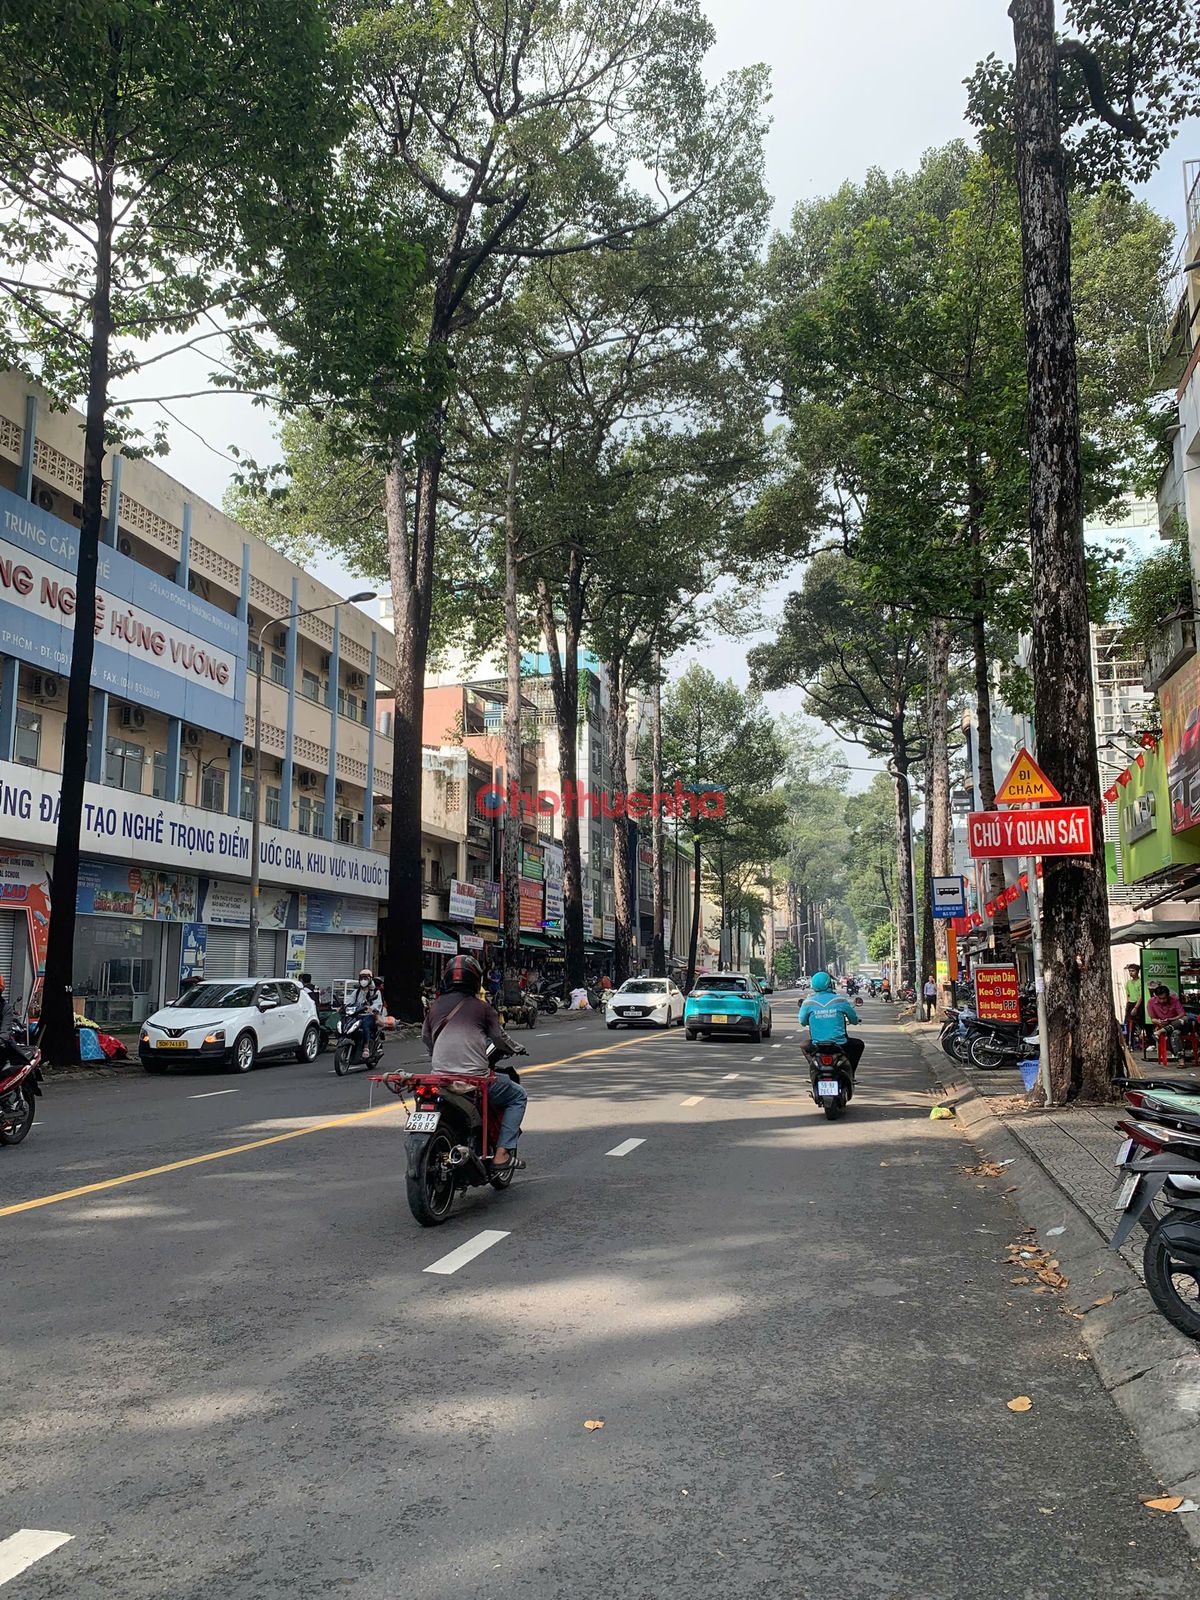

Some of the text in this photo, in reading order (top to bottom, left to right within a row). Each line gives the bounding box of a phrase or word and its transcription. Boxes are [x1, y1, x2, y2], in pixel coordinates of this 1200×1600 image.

[4, 511, 47, 546] TRUNG
[40, 576, 105, 635] NGỆ
[110, 609, 165, 657] HÙNG
[169, 637, 230, 686] VƯƠNG
[1018, 770, 1031, 781] ĐI
[1008, 782, 1044, 797] CHẬM
[973, 812, 1085, 847] CHÚ Ý QUAN SÁT
[84, 803, 116, 838] TẠO
[122, 810, 164, 844] NGHỀ
[169, 821, 214, 856] TRỌNG
[218, 826, 249, 860] ĐIỂM
[260, 837, 282, 866] UỐC
[284, 847, 304, 874] GIA,
[307, 852, 326, 874] KHU
[329, 856, 347, 881] VỰC
[348, 858, 359, 881] VÀ
[361, 861, 382, 886] QUỐC
[978, 972, 1016, 984] Chuyên Dán
[979, 986, 1016, 997] Keo 3 Lớp
[1003, 1000, 1017, 1010] PPF
[412, 1113, 436, 1122] 59-T2
[405, 1121, 435, 1131] 268.82
